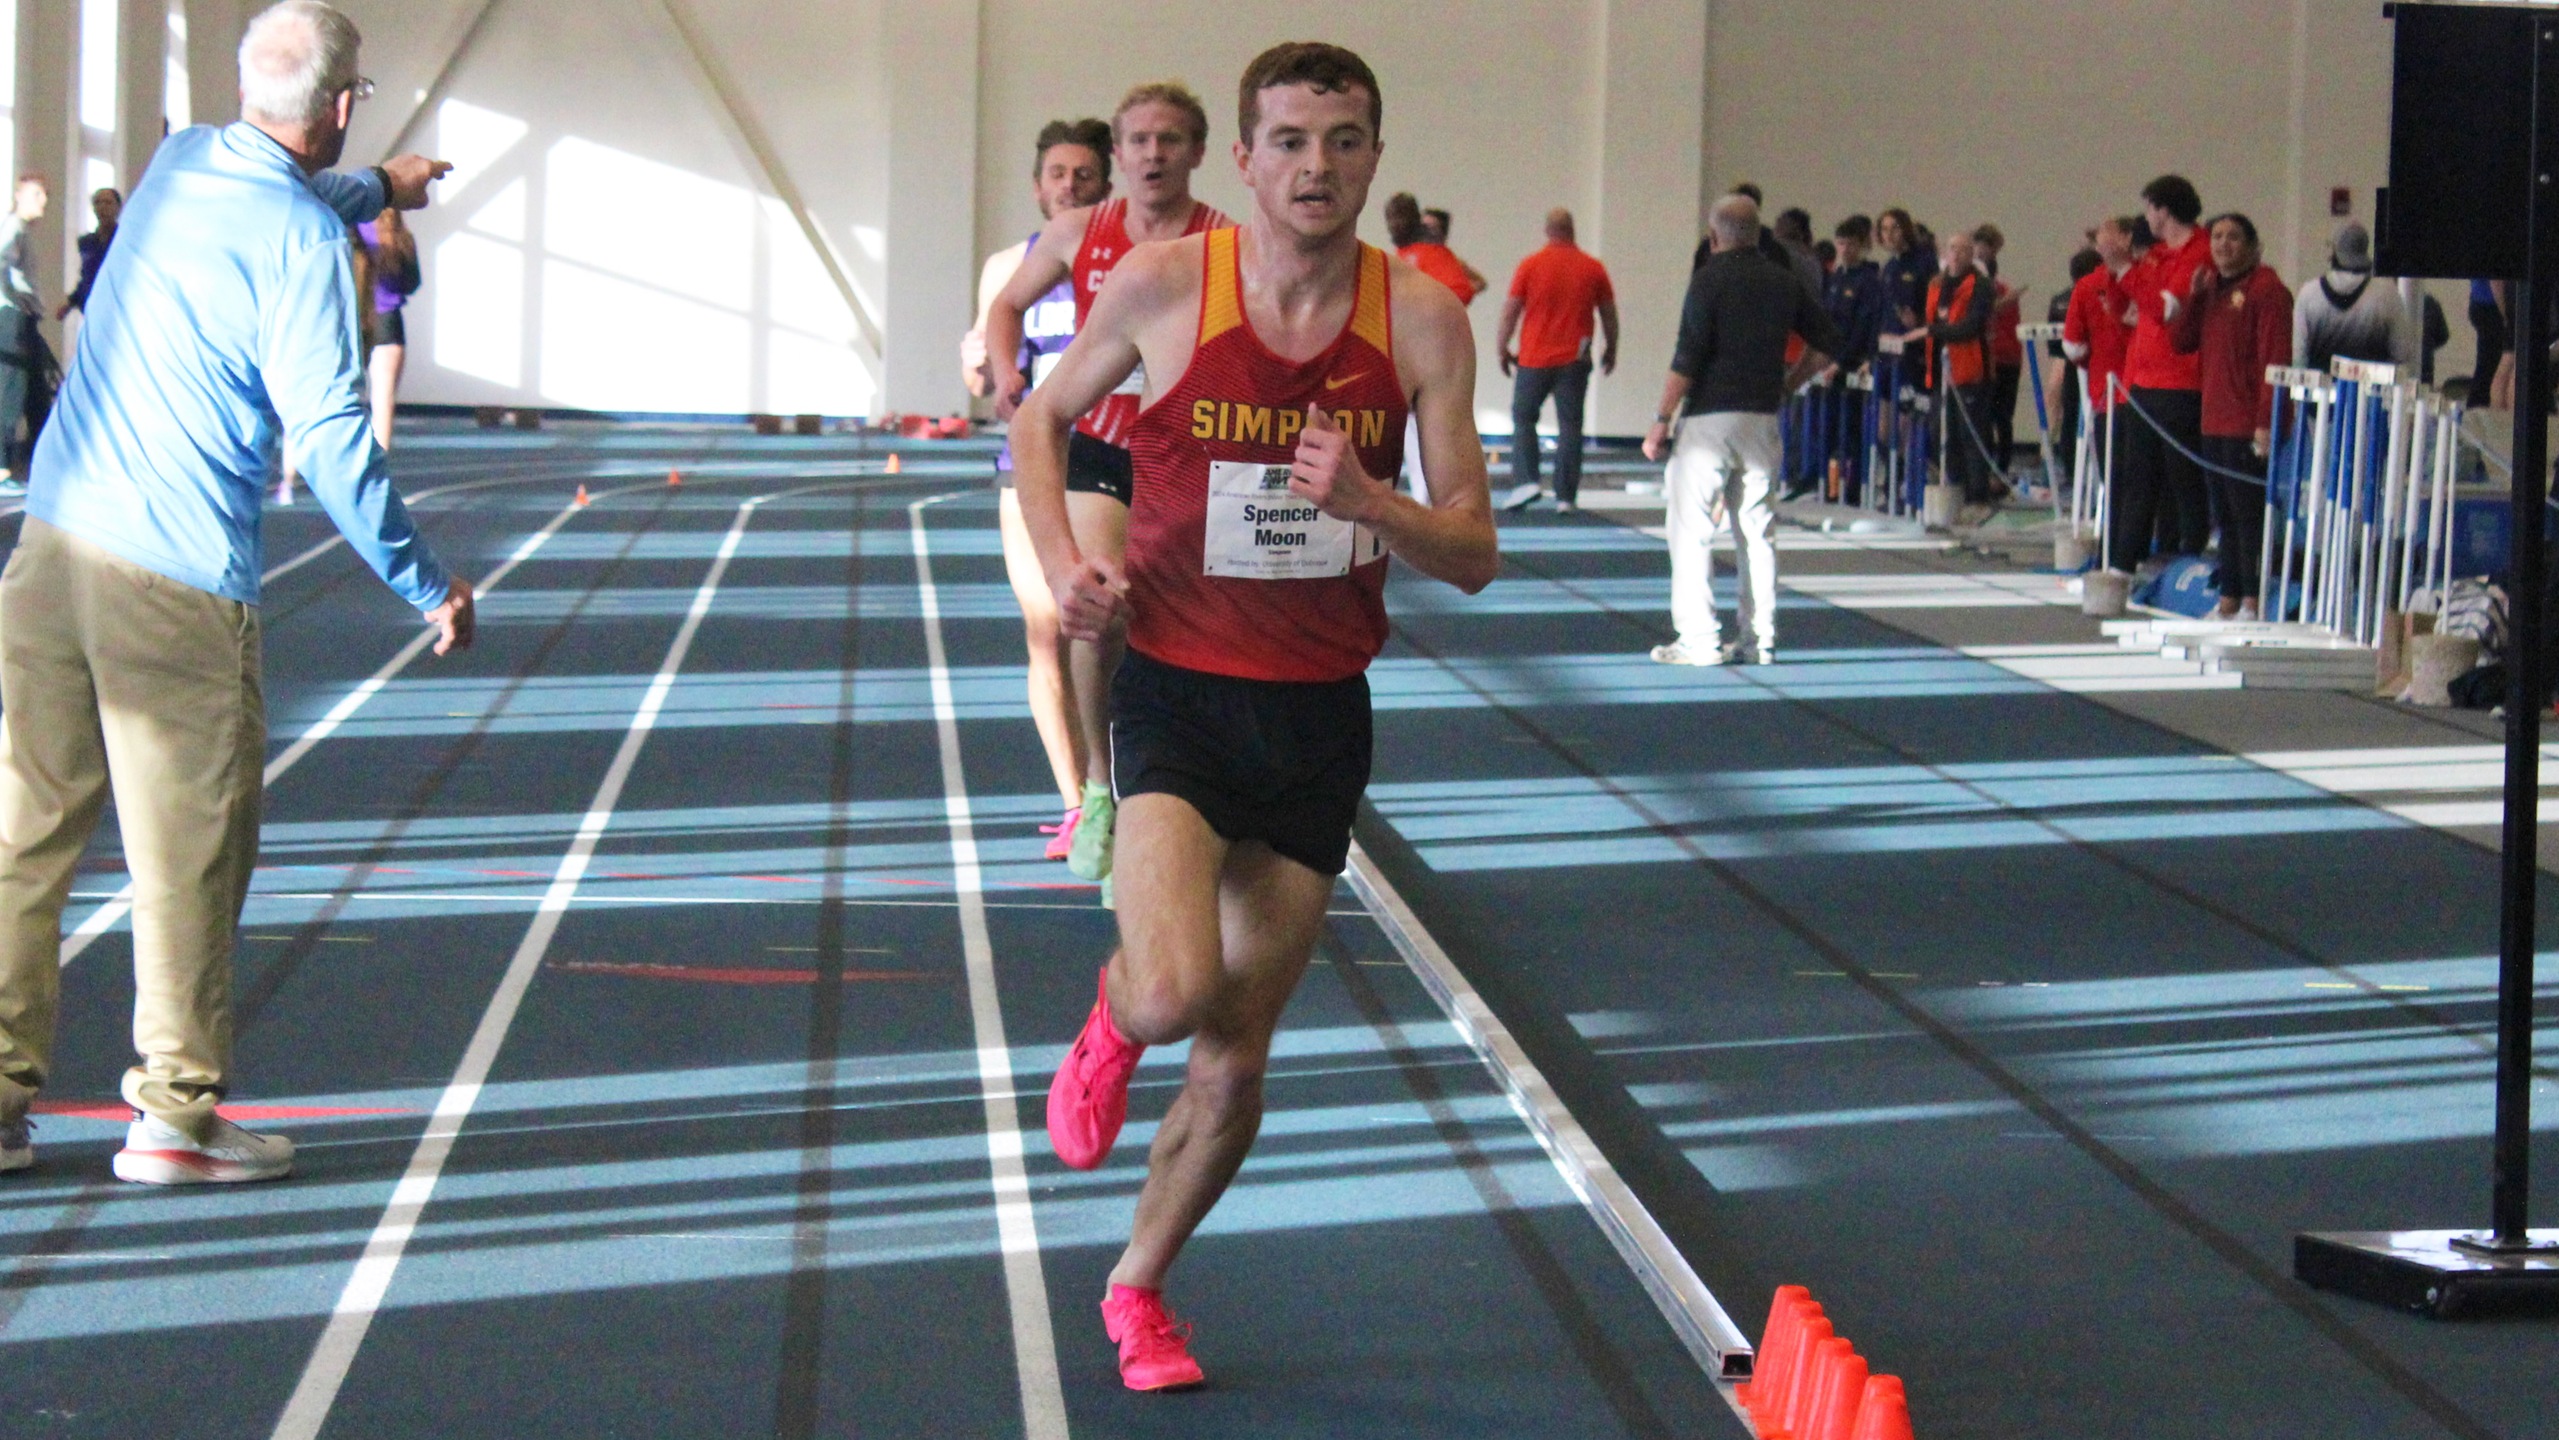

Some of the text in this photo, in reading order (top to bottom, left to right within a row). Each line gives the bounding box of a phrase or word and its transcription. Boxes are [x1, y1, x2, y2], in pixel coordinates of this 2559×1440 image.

[1191, 399, 1386, 448] SIMPON
[1243, 504, 1321, 526] Spencer
[1254, 529, 1307, 546] Moon
